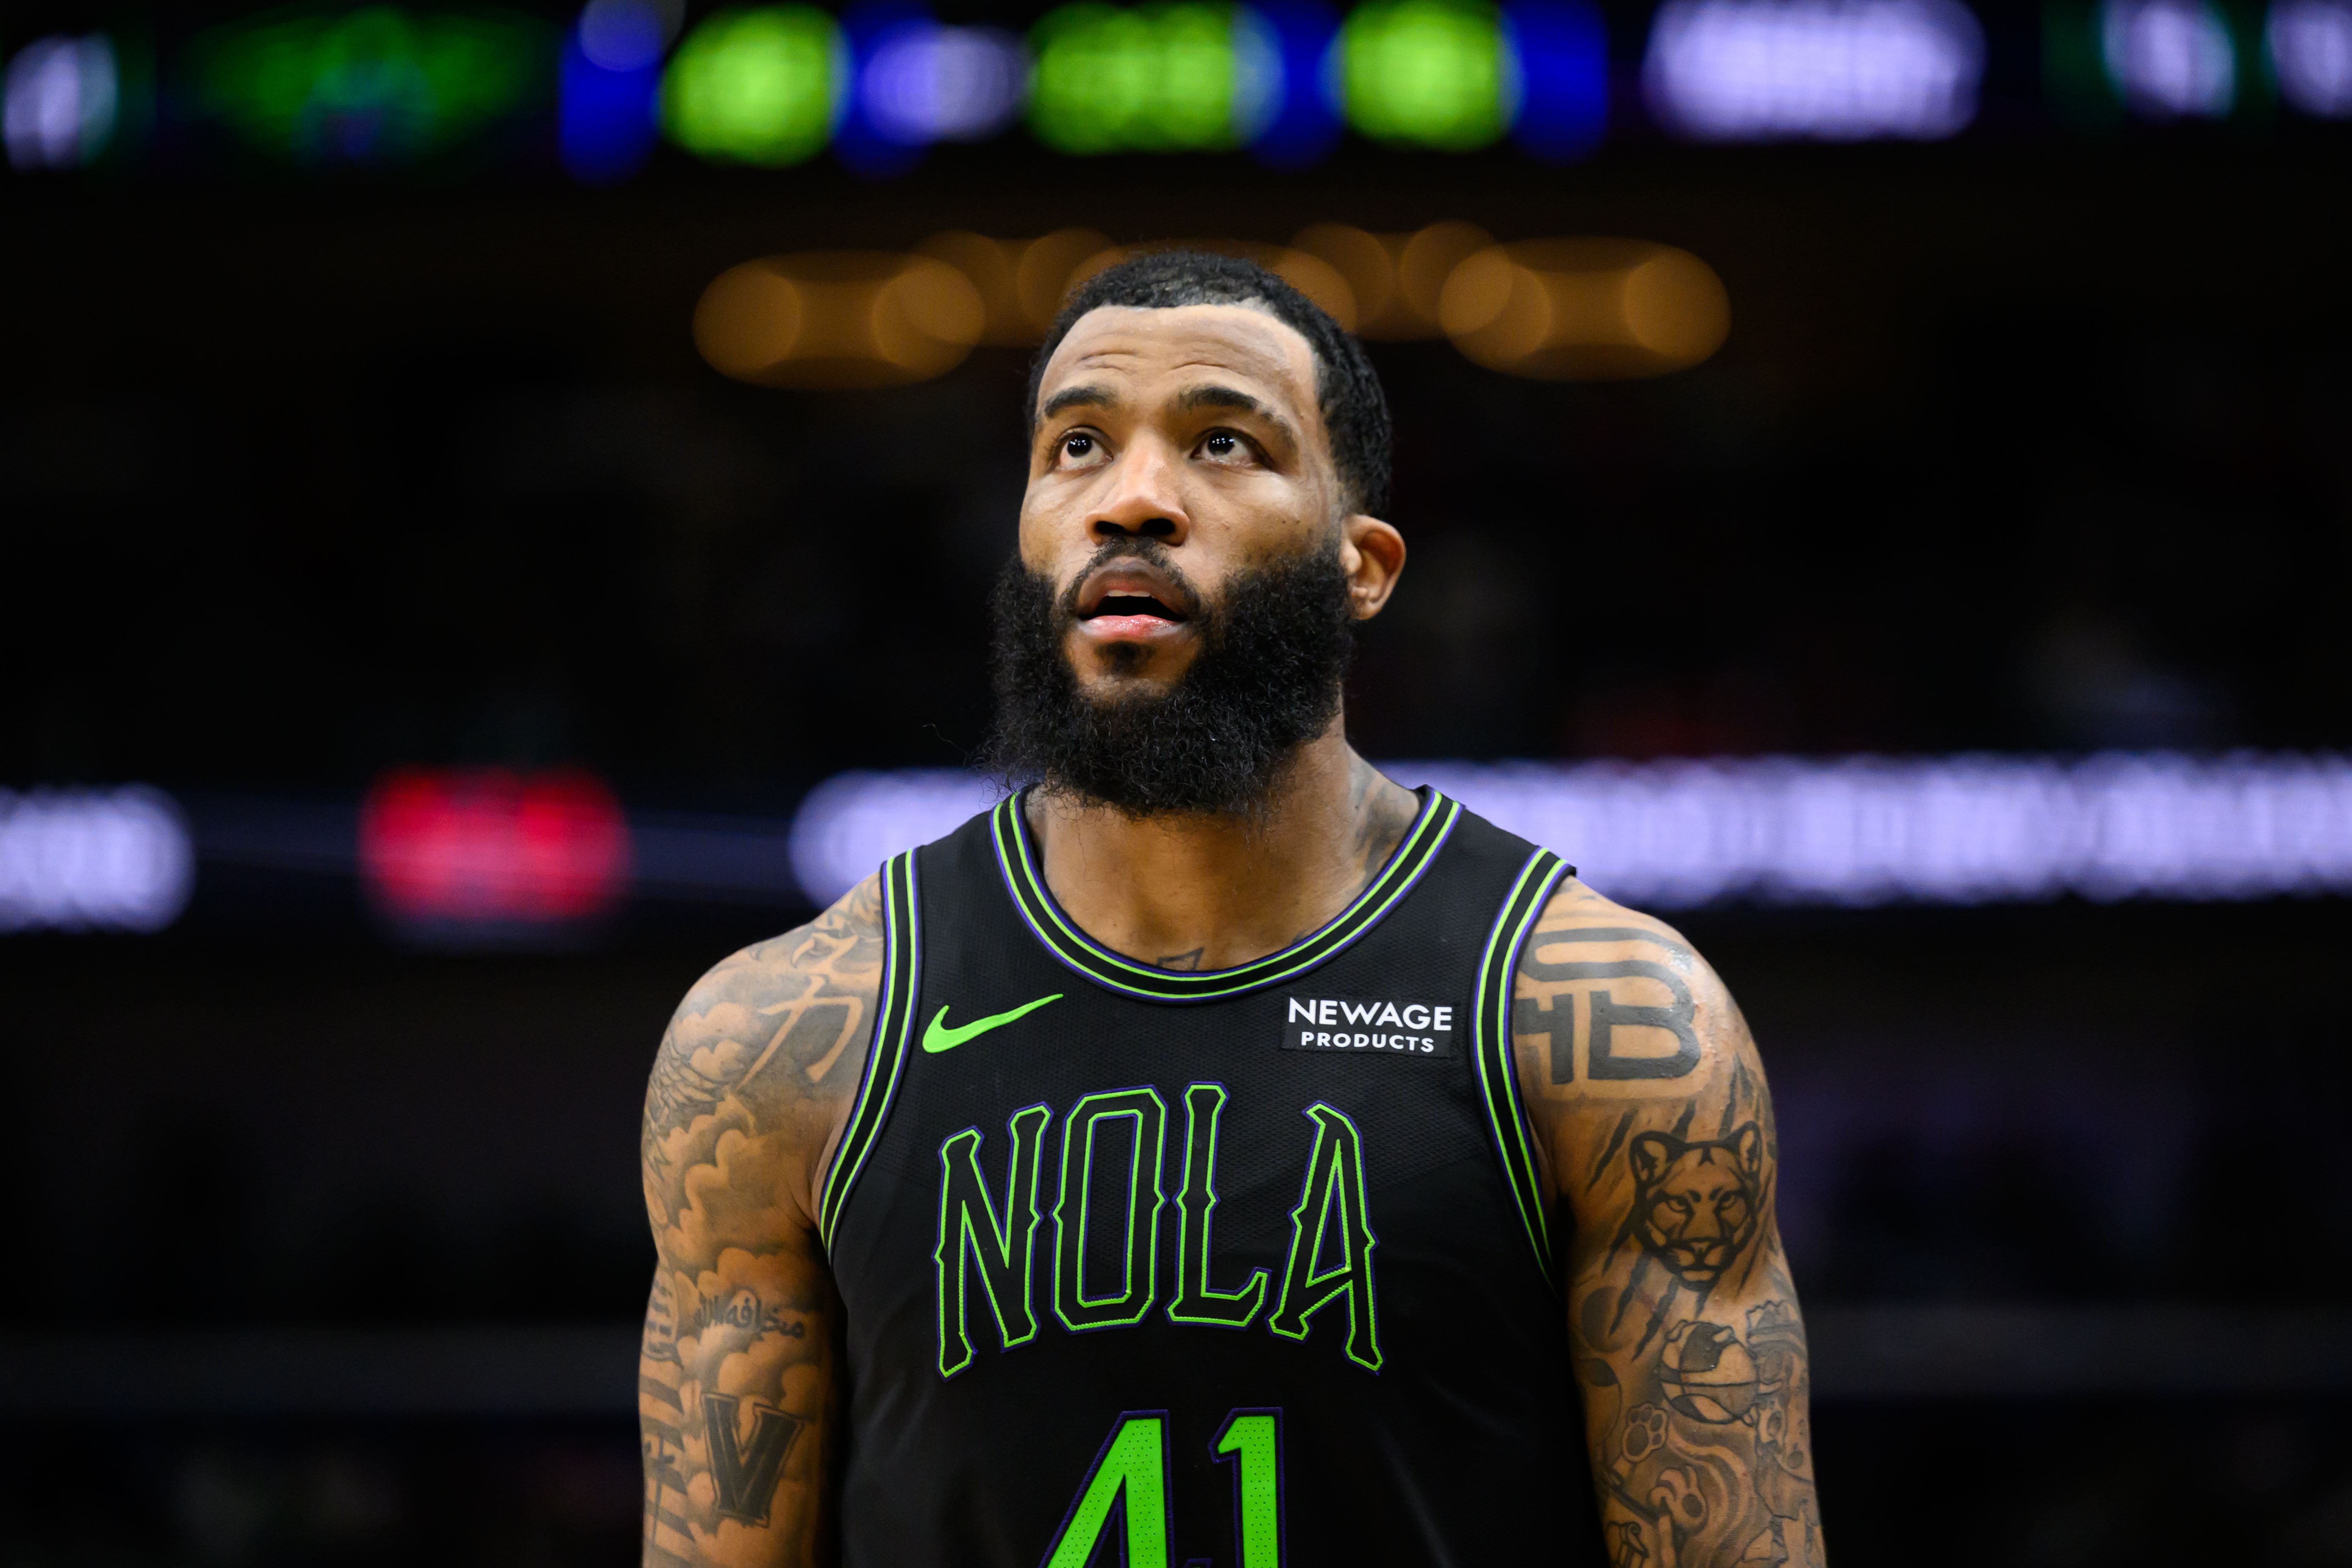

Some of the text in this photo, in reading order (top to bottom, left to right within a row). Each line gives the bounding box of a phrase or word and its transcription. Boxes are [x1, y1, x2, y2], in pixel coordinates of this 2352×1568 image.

[1288, 997, 1452, 1031] NEWAGE
[1301, 1031, 1434, 1053] PRODUCTS
[932, 1081, 1385, 1382] NOLA
[700, 1391, 805, 1528] V
[1037, 1406, 1287, 1568] 41
